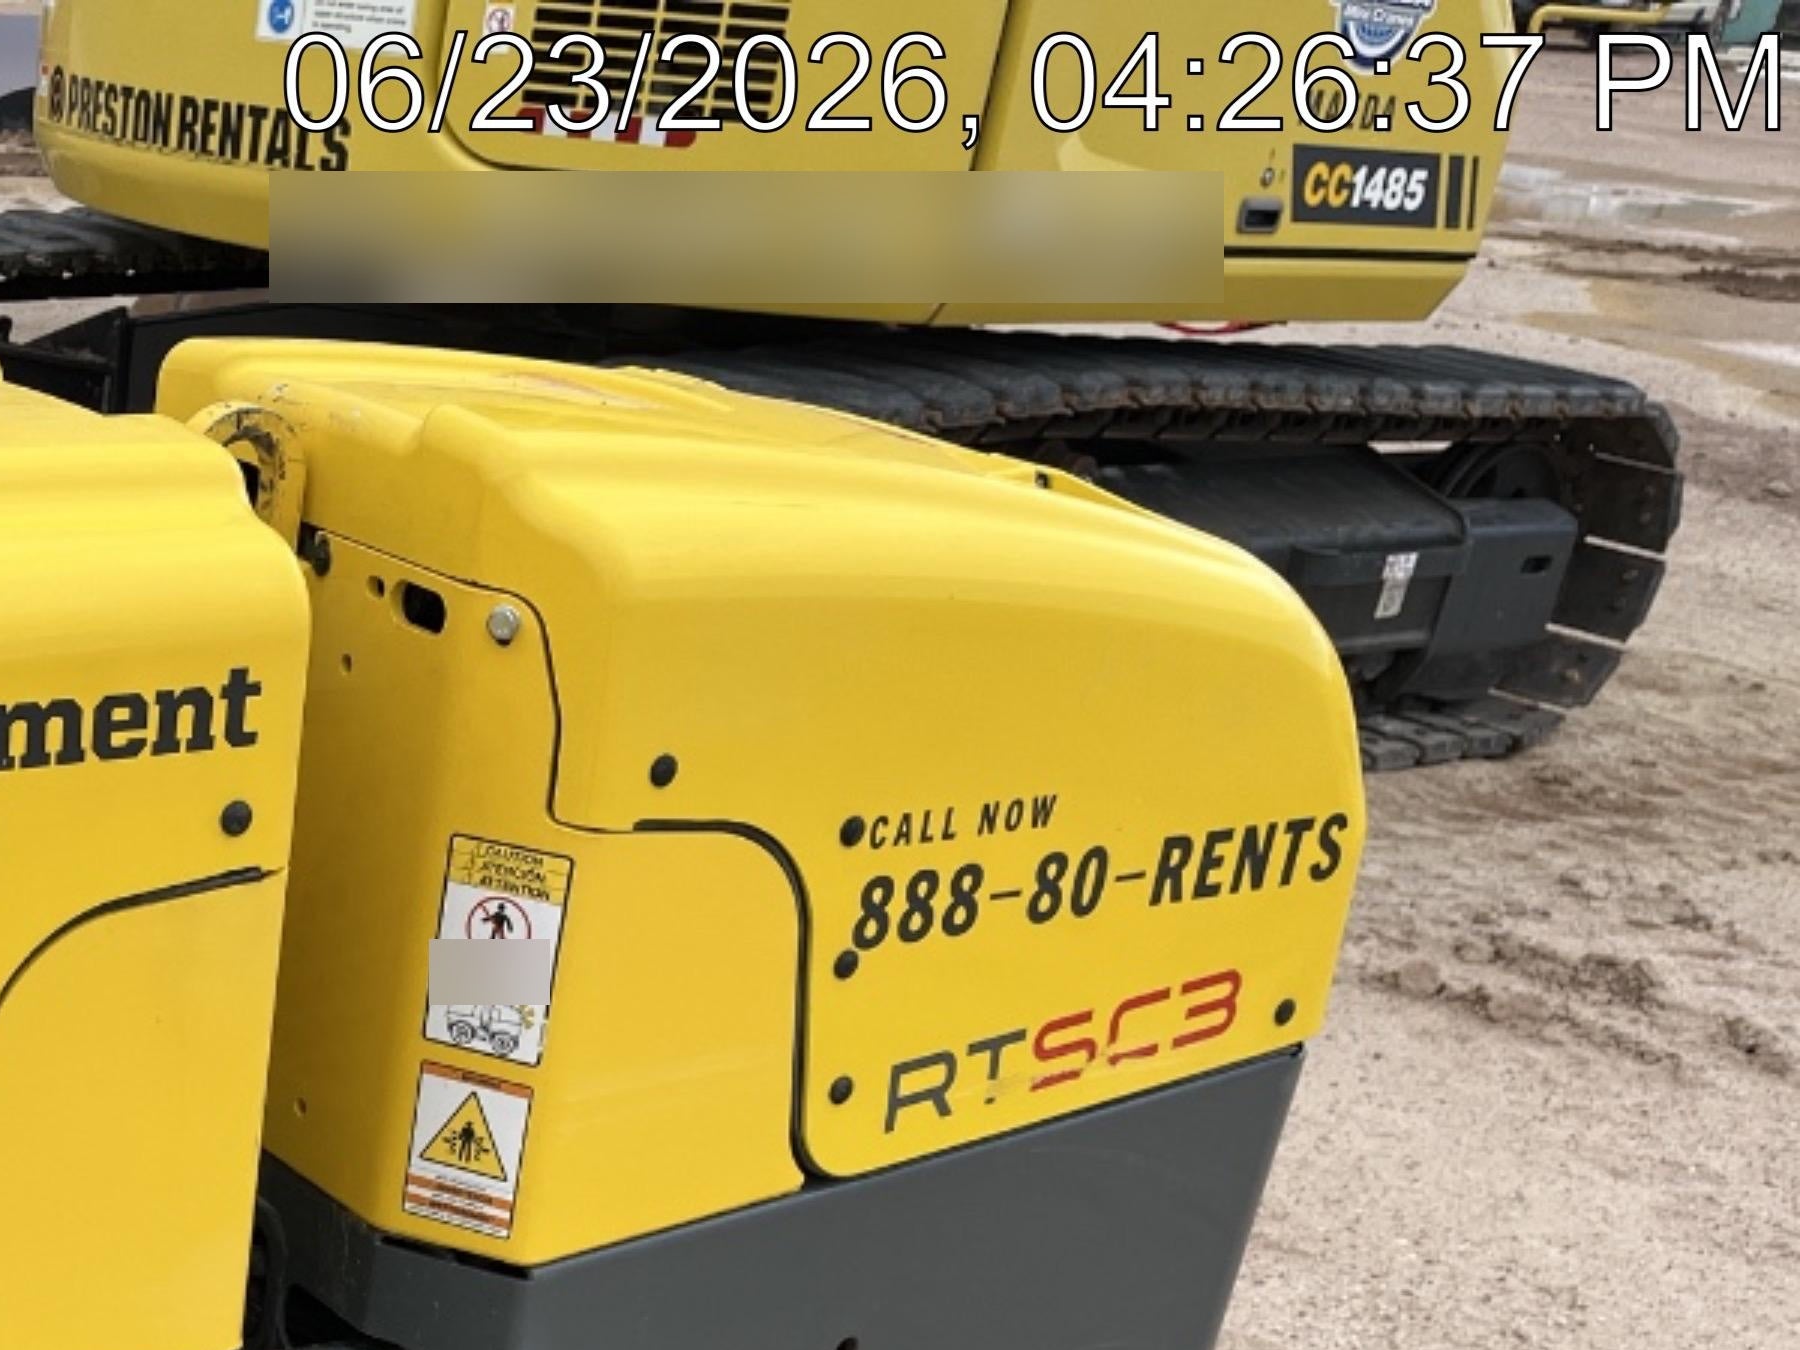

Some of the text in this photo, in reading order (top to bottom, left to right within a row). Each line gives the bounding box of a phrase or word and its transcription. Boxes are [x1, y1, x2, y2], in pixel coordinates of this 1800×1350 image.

[66, 73, 176, 149] PRESTON
[1304, 160, 1429, 212] CC1485
[868, 794, 1059, 849] CALL NOW
[851, 811, 1350, 951] 888-80-RENTS
[883, 968, 1243, 1135] RTSC3
